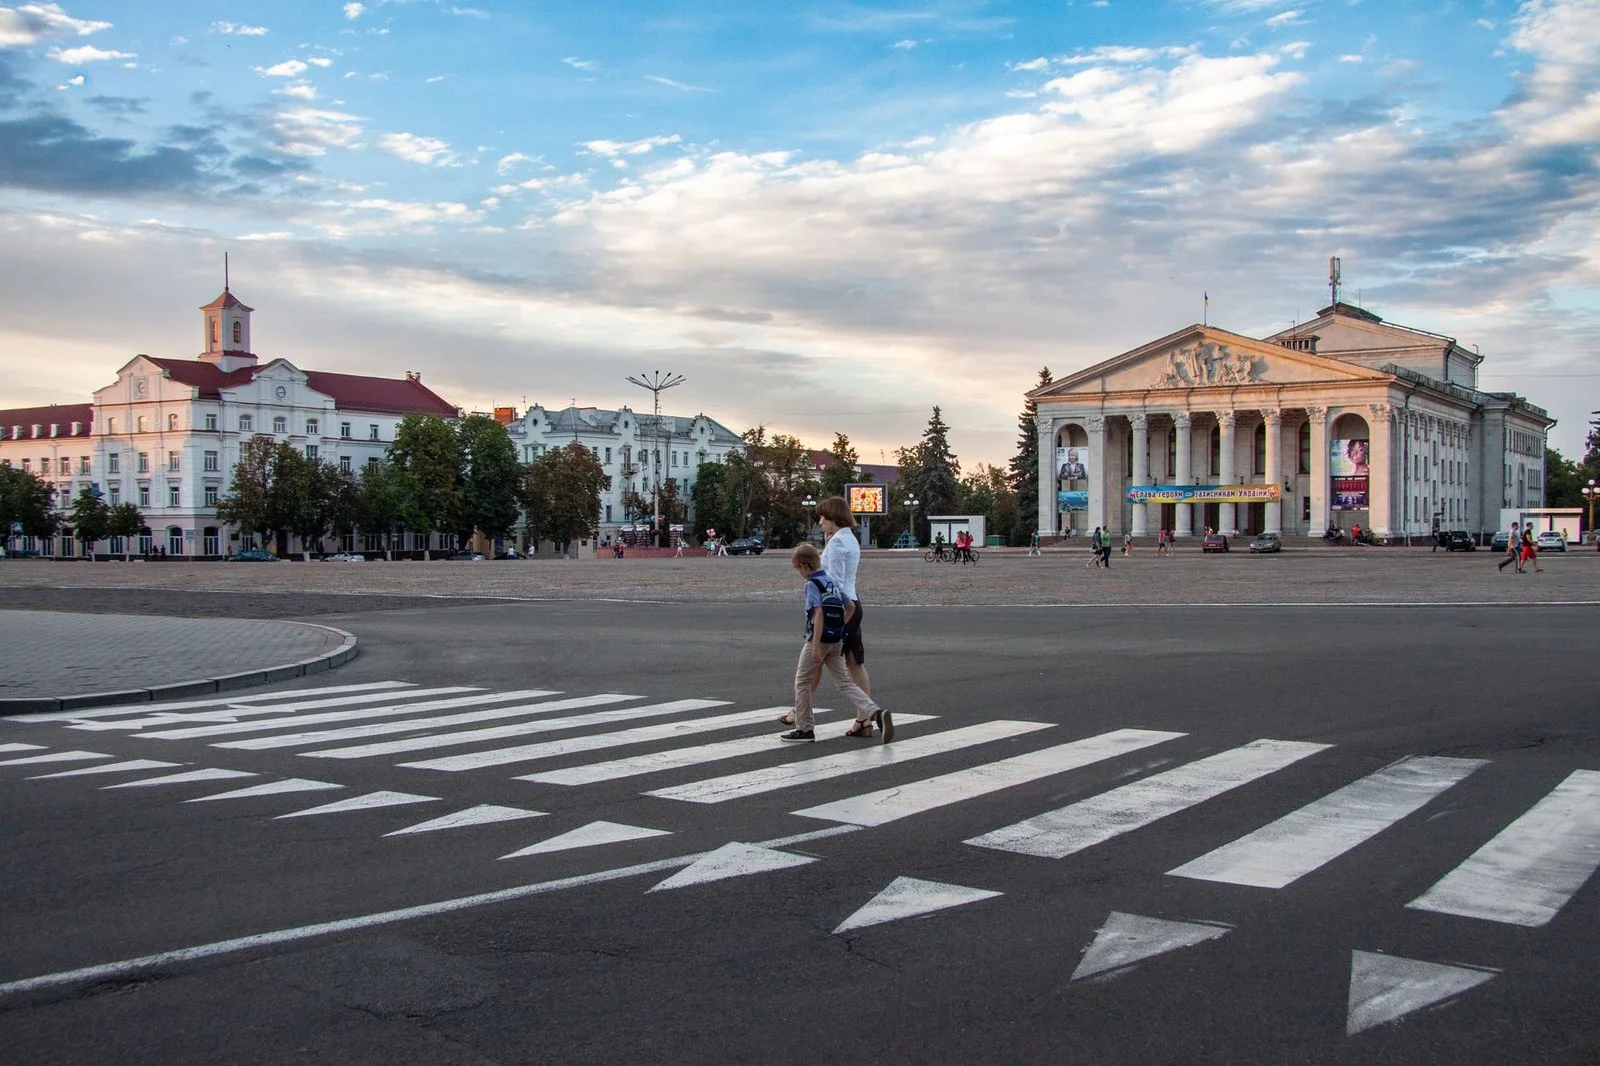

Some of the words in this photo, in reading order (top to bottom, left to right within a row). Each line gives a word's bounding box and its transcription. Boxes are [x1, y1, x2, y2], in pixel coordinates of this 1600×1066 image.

[1135, 490, 1156, 498] Слава
[1158, 491, 1183, 499] героям
[1195, 490, 1236, 498] захисникам
[1238, 488, 1270, 498] України!
